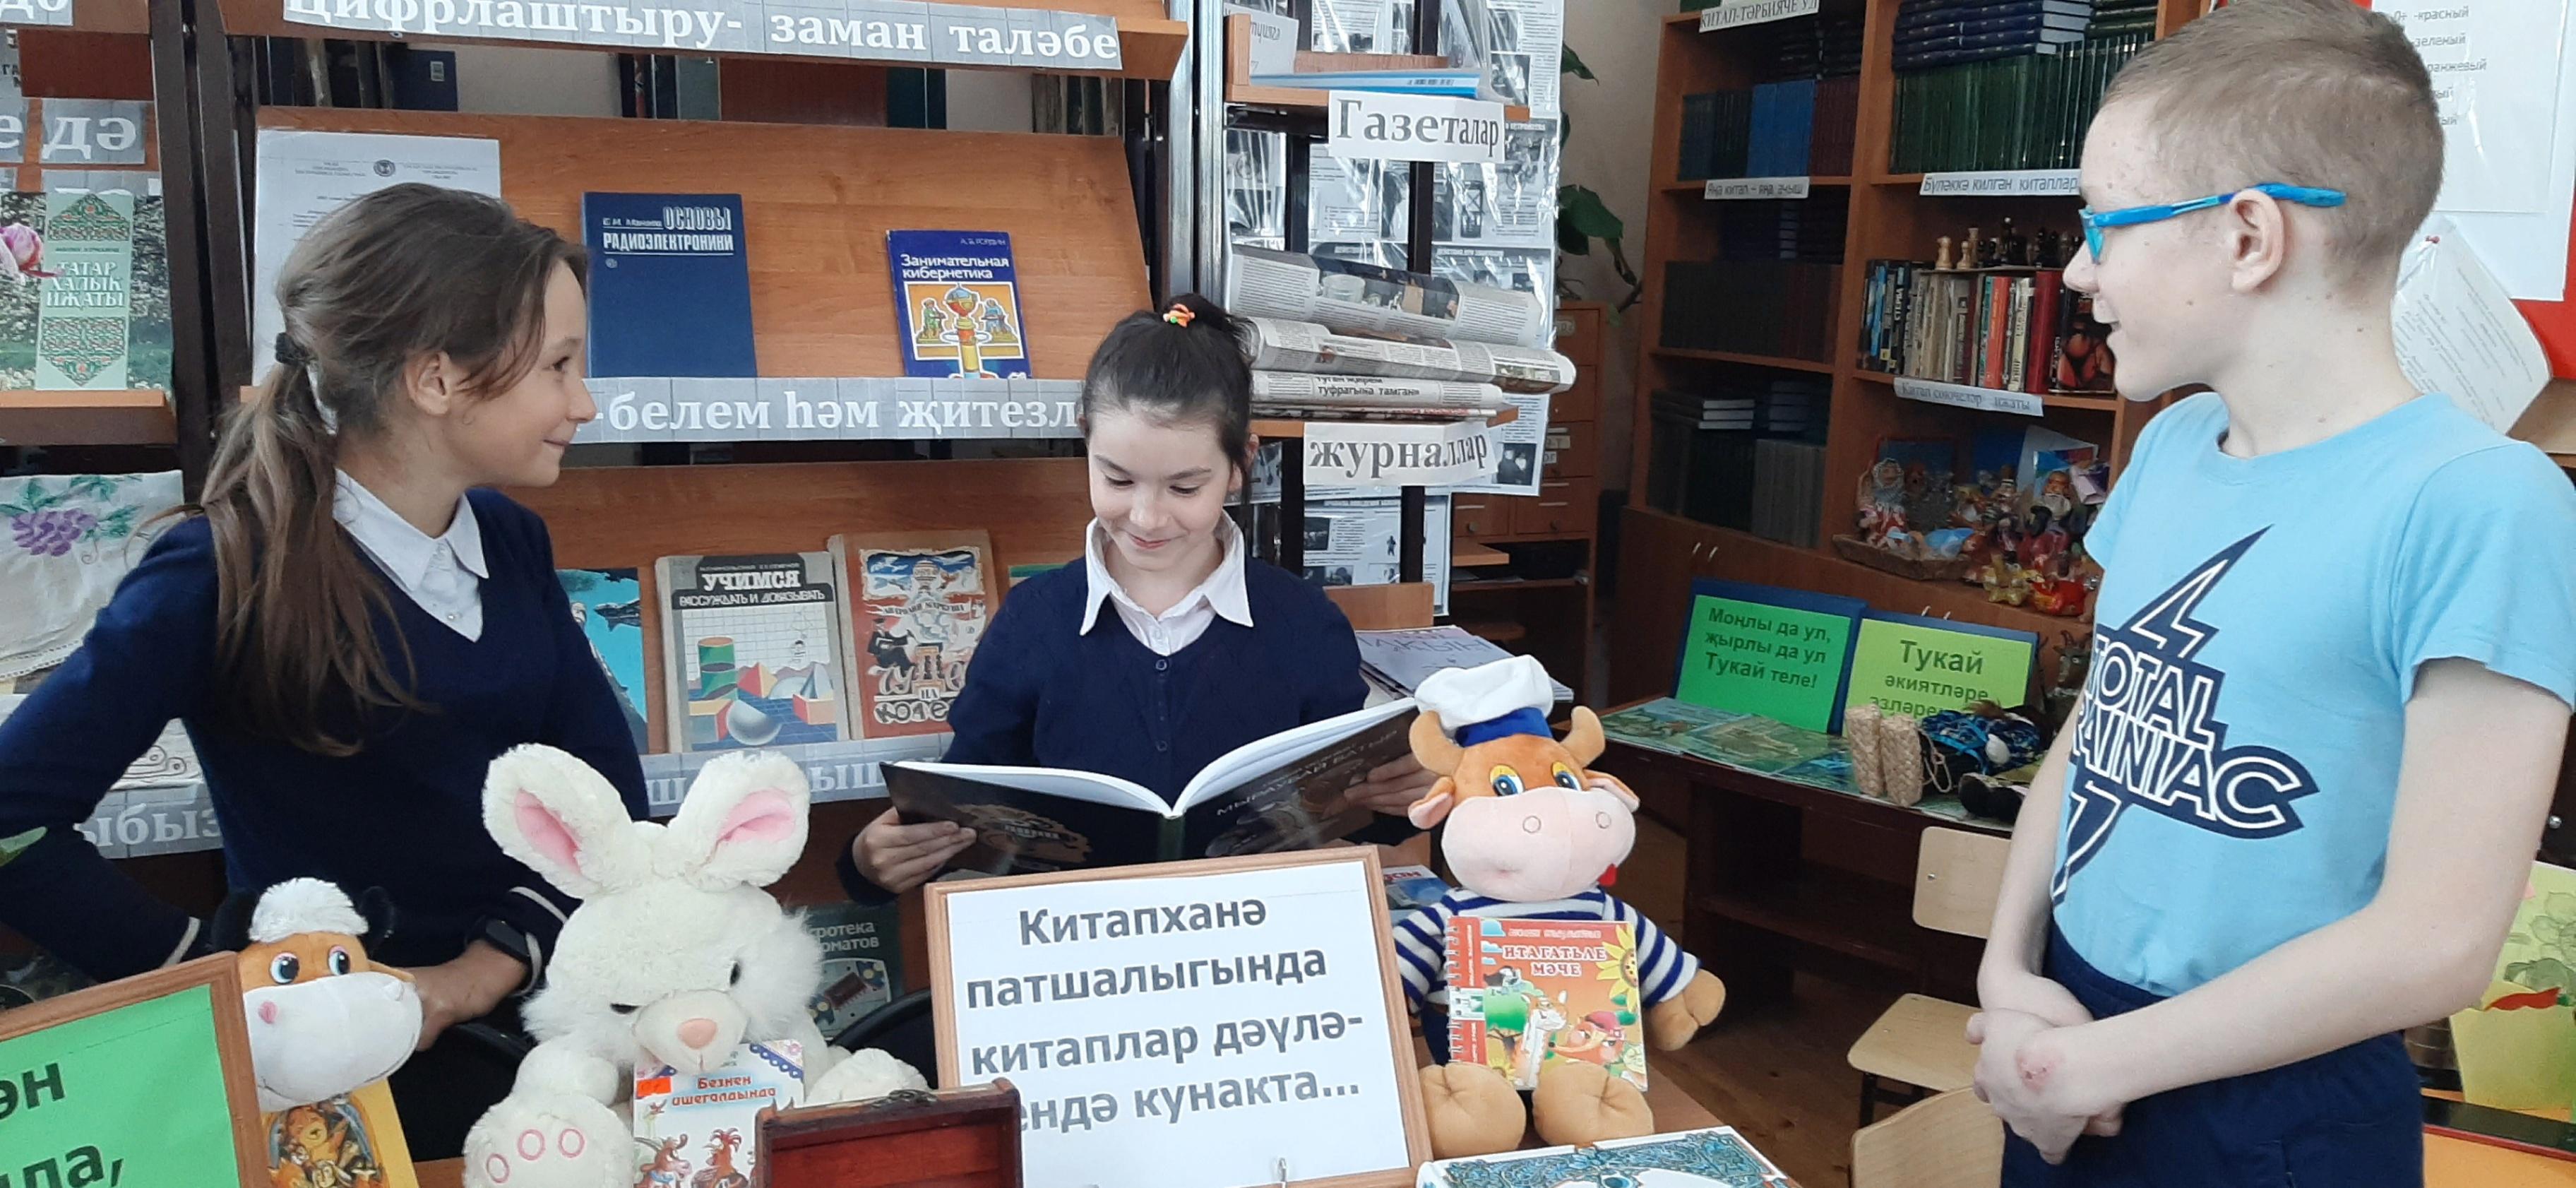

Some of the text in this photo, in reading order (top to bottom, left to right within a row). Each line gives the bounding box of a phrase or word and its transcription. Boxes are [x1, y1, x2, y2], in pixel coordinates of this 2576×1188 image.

[771, 13, 926, 51] заман
[949, 23, 1117, 59] таләбе
[42, 117, 136, 160] дә
[1338, 99, 1498, 157] Газеталар
[662, 207, 732, 230] ОСНОВЫ
[603, 232, 734, 252] РАДИОЭЛЕКТРОНИКИ
[900, 254, 1010, 268] Занимательная
[903, 266, 993, 282] кибернетика
[785, 391, 879, 429] һәм
[1309, 434, 1487, 480] журналлар
[701, 570, 801, 592] УЧИМСЯ
[679, 593, 749, 607] РАССУЖДАТЬ
[750, 593, 759, 604] И
[1708, 607, 1830, 643] Моңлы да ул,
[1705, 632, 1826, 665] җырлы да ул
[1900, 639, 1983, 675] Тукай
[1705, 652, 1818, 689] Тукай теле!
[1885, 675, 1988, 703] әкиятләре
[1018, 898, 1267, 946] Китапханә
[967, 948, 1327, 1009] патшалыгында
[1531, 962, 1582, 976] МӘЧЕ
[971, 1010, 1363, 1076] китаплар дәүлә-
[1133, 1069, 1359, 1124] кунакта...
